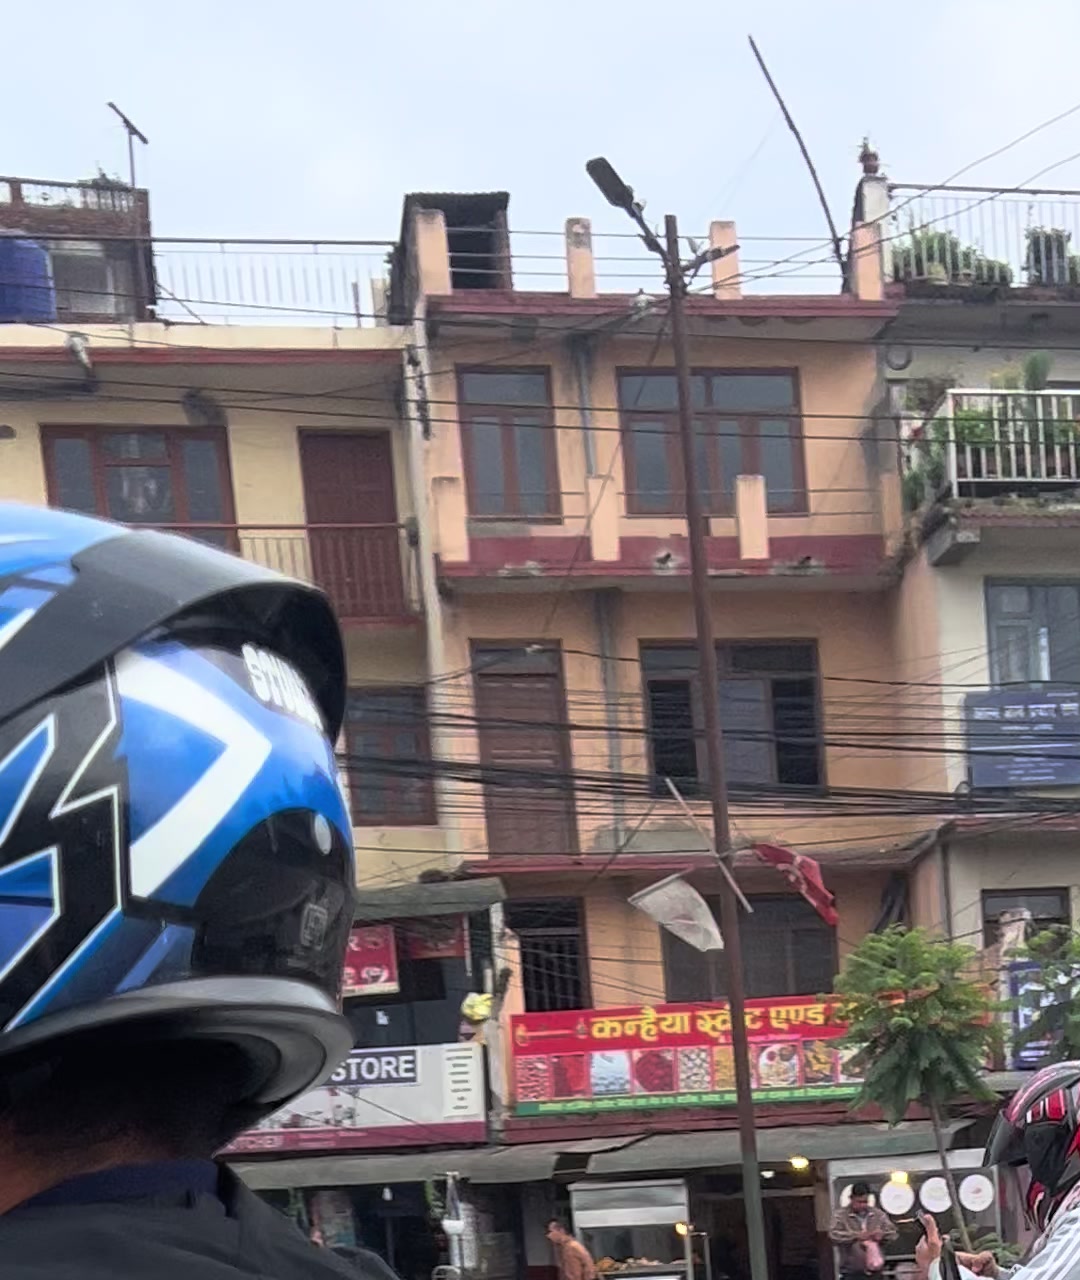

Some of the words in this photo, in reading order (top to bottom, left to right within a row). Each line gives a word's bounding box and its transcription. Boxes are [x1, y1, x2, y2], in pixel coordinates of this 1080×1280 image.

[590, 1006, 692, 1042] कन्हैया
[695, 1005, 765, 1038] स्वट
[769, 1004, 826, 1031] एण्ड
[331, 1055, 415, 1082] STORE
